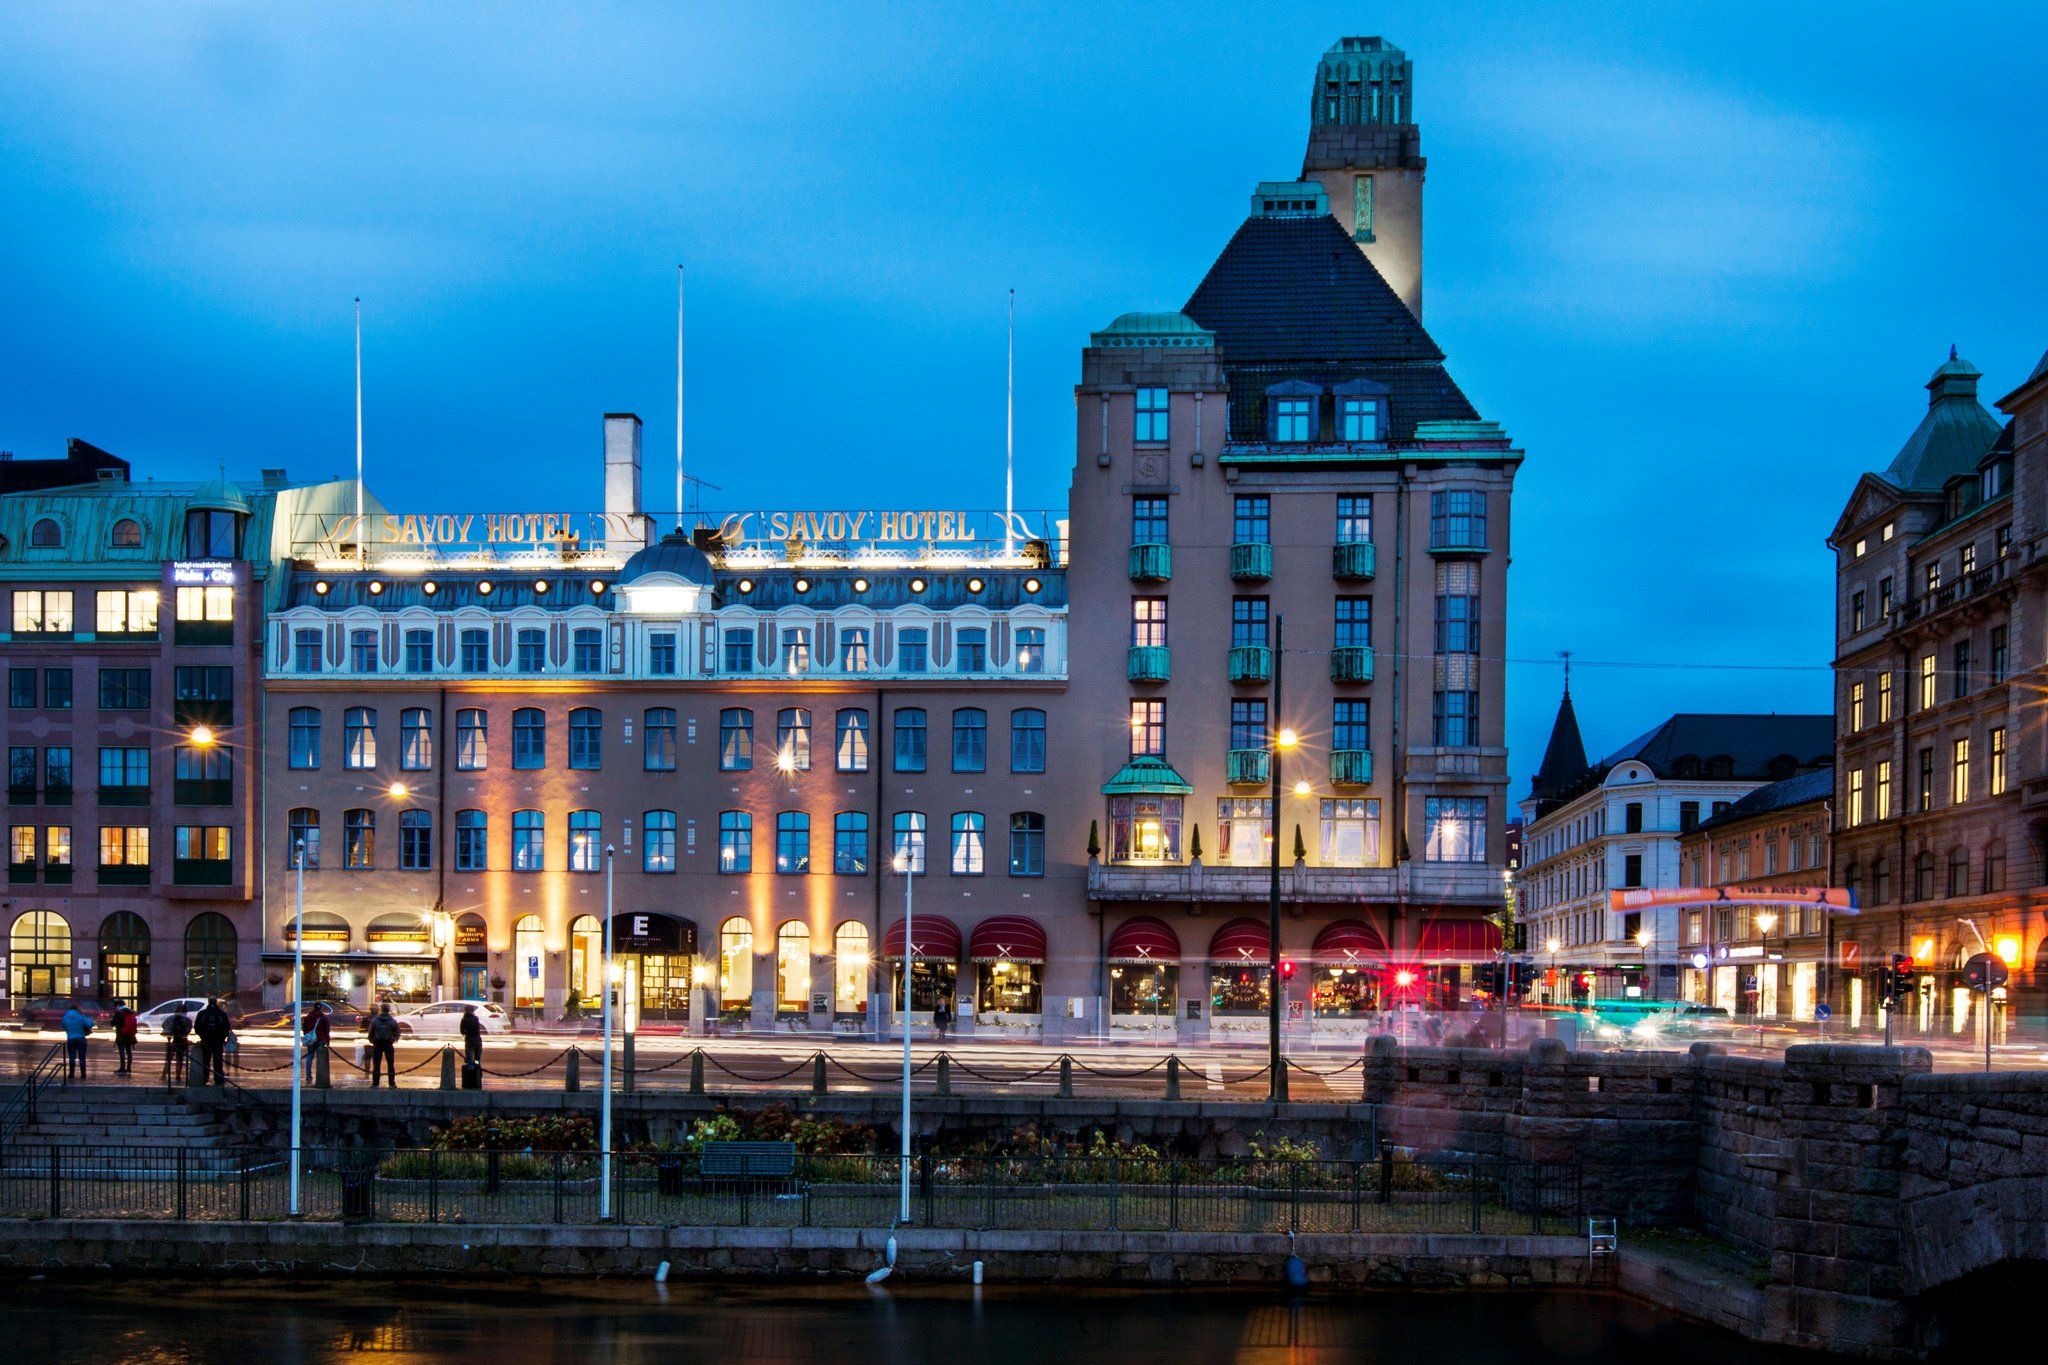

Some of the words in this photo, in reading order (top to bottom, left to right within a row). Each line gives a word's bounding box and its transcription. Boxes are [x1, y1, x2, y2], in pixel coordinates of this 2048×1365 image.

[382, 514, 474, 542] SAVOY
[488, 513, 579, 542] HOTEL
[770, 512, 866, 540] SAVOY
[880, 512, 975, 540] HOTEL
[634, 916, 649, 936] E
[531, 957, 537, 967] P
